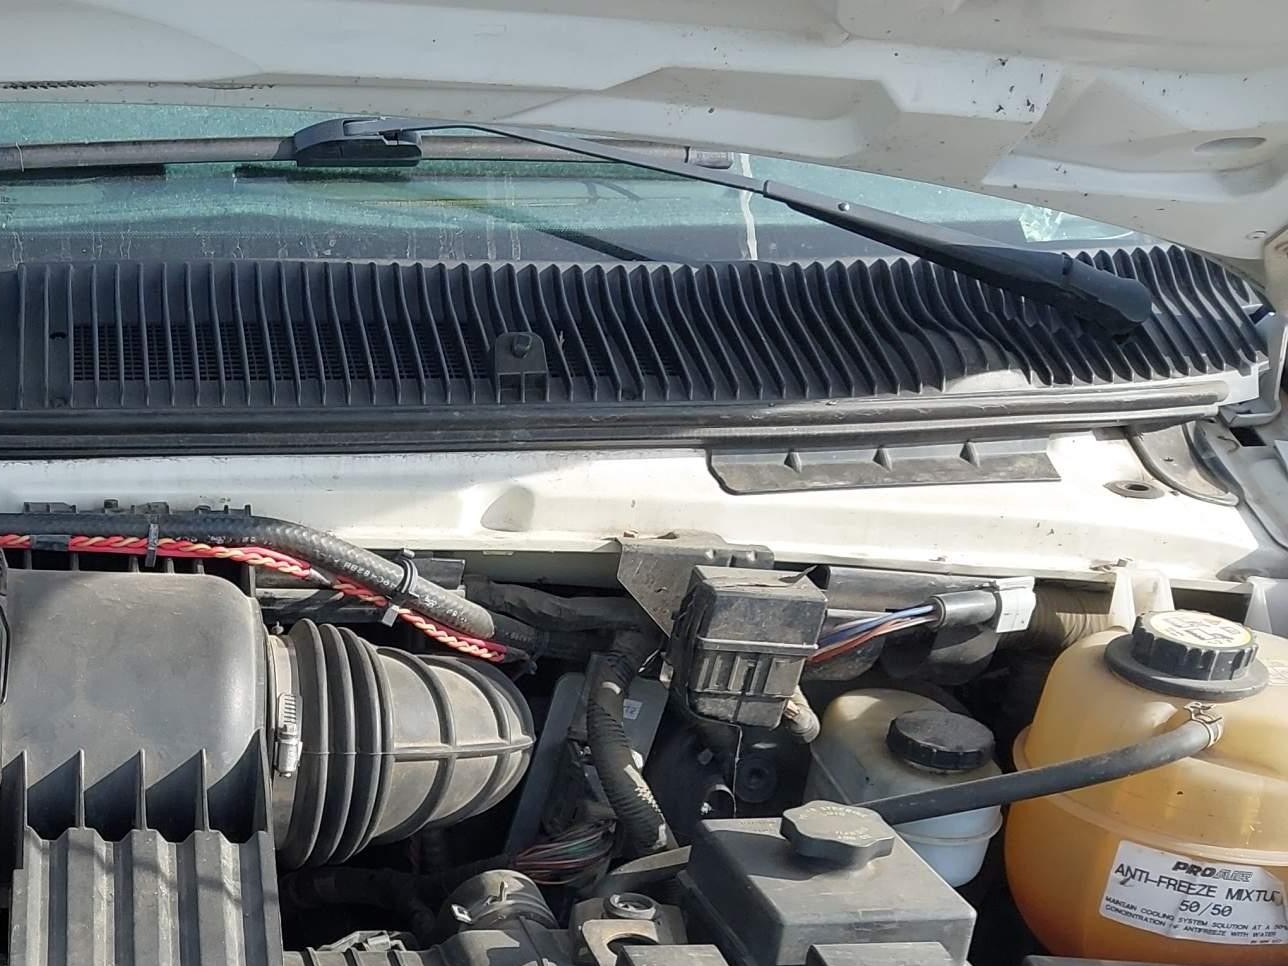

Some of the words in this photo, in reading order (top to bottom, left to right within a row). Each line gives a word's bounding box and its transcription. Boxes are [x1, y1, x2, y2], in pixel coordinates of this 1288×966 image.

[1114, 863, 1218, 898] ANTI-FREEZE
[1105, 896, 1137, 911] MAINTAIN
[1140, 907, 1175, 921] COOLING
[1178, 917, 1208, 926] SYSTEM
[1212, 922, 1249, 930] SOLUTION
[1105, 904, 1166, 926] CONCENTRATION
[1178, 900, 1232, 917] 50/50
